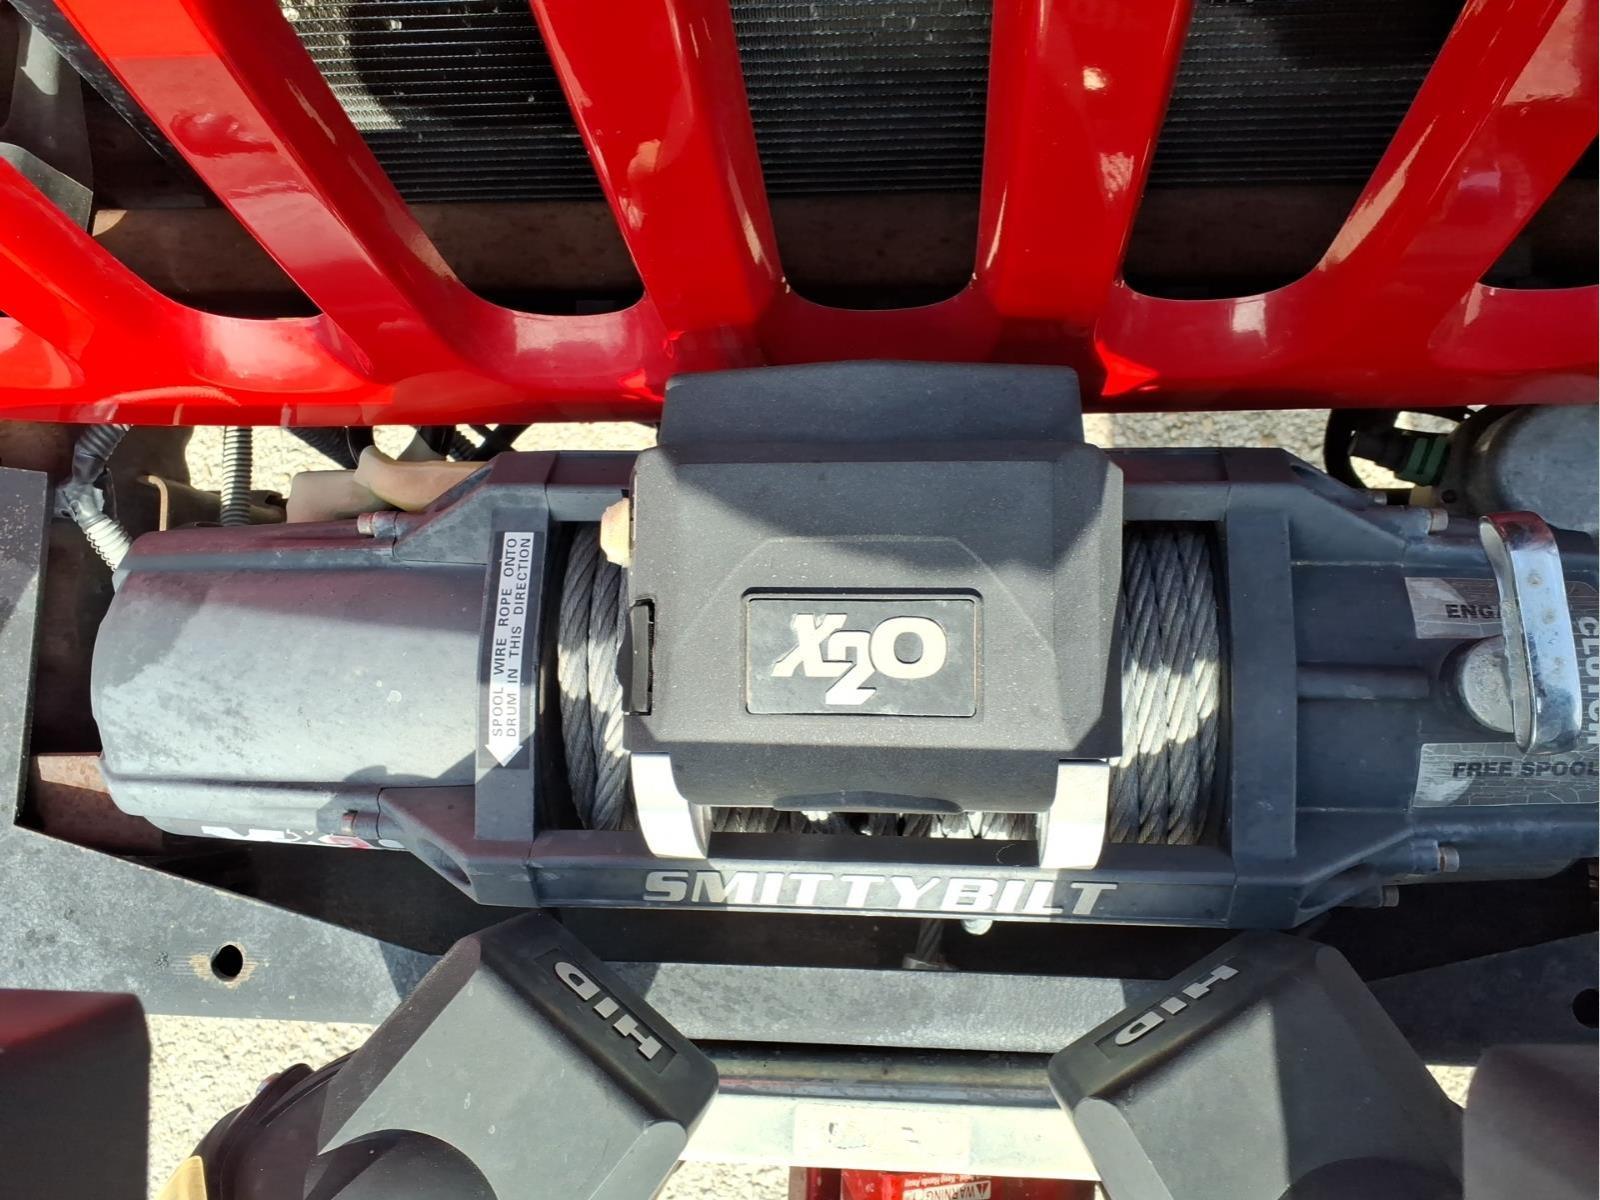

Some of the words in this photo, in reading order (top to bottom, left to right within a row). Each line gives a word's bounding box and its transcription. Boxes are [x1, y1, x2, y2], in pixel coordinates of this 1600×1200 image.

[504, 538, 517, 577] ONTO
[514, 538, 531, 616] DIRECTION
[498, 589, 513, 627] ROPE
[1446, 604, 1501, 619] ENG
[494, 638, 508, 676] WIRE
[509, 626, 522, 658] THIS
[507, 669, 518, 684] IN
[492, 687, 504, 737] SPOOL
[506, 692, 517, 737] DRUM
[1452, 761, 1513, 778] FREE
[1519, 761, 1599, 777] SPOOL
[643, 871, 1118, 916] SMITTYBILT
[554, 961, 663, 1060] HID
[1114, 965, 1239, 1046] HID
[926, 1186, 975, 1200] WARNING
